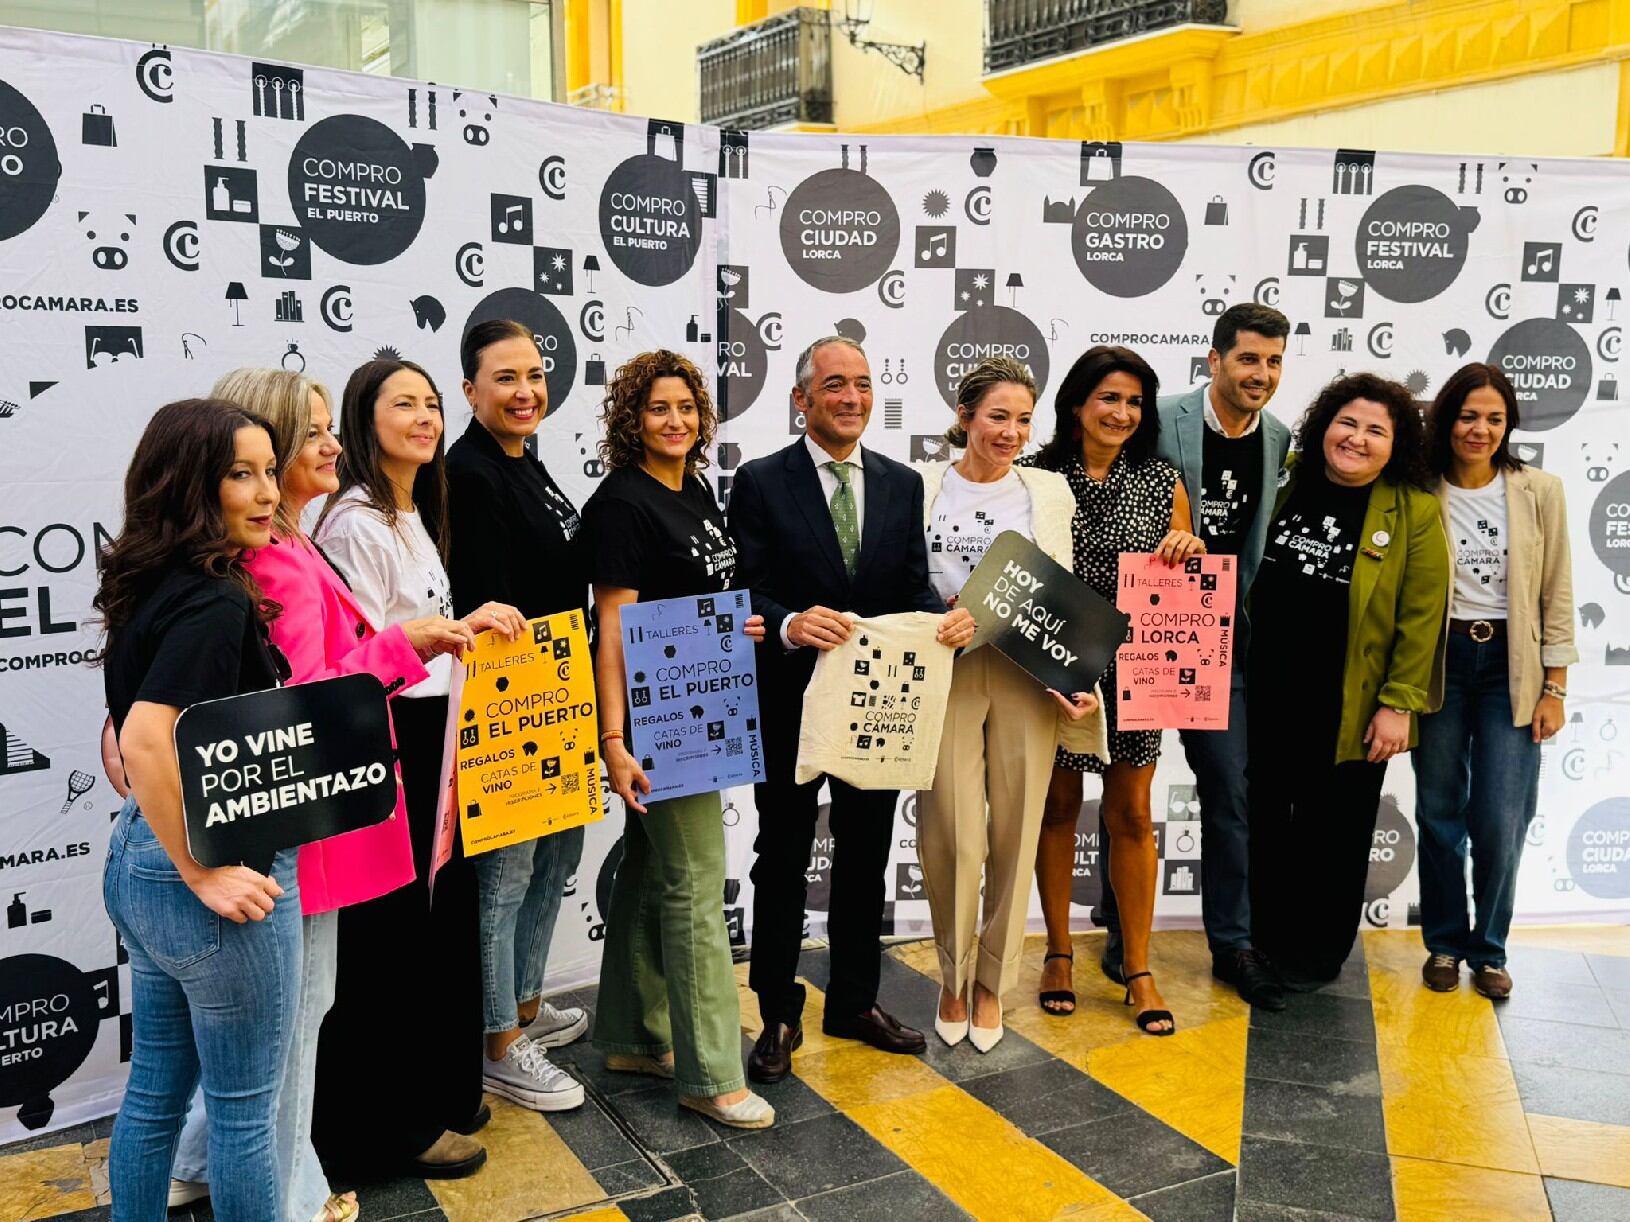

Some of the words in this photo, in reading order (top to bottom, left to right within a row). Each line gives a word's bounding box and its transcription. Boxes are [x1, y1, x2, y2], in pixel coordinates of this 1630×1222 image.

[303, 157, 402, 185] COMPRO
[303, 182, 410, 211] FESTIVAL
[610, 192, 686, 217] COMPRO
[308, 207, 324, 220] EL
[326, 209, 379, 224] PUERTO
[799, 209, 881, 227] COMPRO
[1086, 211, 1170, 230] COMPRO
[610, 214, 691, 239] CULTURA
[1367, 220, 1450, 239] COMPRO
[613, 235, 625, 247] EL
[627, 237, 668, 251] PUERTO
[800, 228, 878, 247] CIUDAD
[1085, 232, 1165, 251] GASTRO
[802, 248, 842, 261] LORCA
[1086, 251, 1125, 263] LORCA
[1366, 240, 1454, 259] FESTIVAL
[1367, 259, 1404, 271] LORCA
[1090, 333, 1210, 345] COMPROCAMARA
[946, 342, 1030, 359] COMPRO
[1501, 354, 1576, 372] COMPRO
[1515, 391, 1538, 401] RCA
[1200, 499, 1231, 510] OMPRO
[946, 535, 992, 546] COMPRO
[1291, 534, 1333, 553] COMPRO
[1003, 559, 1044, 594] HOY
[1136, 577, 1183, 588] TALLERES
[993, 576, 1021, 602] DE
[1019, 598, 1067, 636] AQUÍ
[1140, 612, 1216, 627] COMPRO
[645, 625, 699, 641] TALLERES
[982, 591, 1011, 619] NO
[1011, 613, 1041, 642] ME
[1041, 633, 1079, 667] VOY
[1141, 630, 1200, 645] LORCA
[479, 652, 535, 673] TALLERES
[1118, 652, 1159, 661] REGALOS
[655, 659, 732, 682] COMPRO
[1132, 667, 1160, 676] CATAS
[1162, 667, 1175, 676] DE
[659, 685, 681, 701] EL
[686, 673, 754, 697] PUERTO
[1133, 677, 1155, 685] VINO
[485, 687, 570, 719] COMPRO
[489, 721, 513, 739] EL
[518, 702, 593, 732] PUERTO
[633, 711, 684, 727] REGALOS
[865, 710, 917, 724] COMPRO
[653, 725, 688, 741] CATAS
[689, 723, 704, 735] DE
[194, 739, 239, 767] YO
[245, 722, 315, 757] VINE
[654, 739, 682, 751] VINO
[459, 748, 516, 771] REGALOS
[201, 763, 263, 798] POR
[271, 754, 305, 781] EL
[480, 765, 520, 784] CATAS
[521, 761, 537, 775] DE
[205, 762, 388, 829] AMBIENTAZO
[481, 779, 513, 795] VINO
[1582, 830, 1630, 846] COMP
[1582, 846, 1630, 862] CIUDA
[1582, 863, 1617, 874] LORCA
[0, 993, 70, 1024] MPRO
[0, 1016, 79, 1051] TURA
[0, 1047, 44, 1067] ERTO
